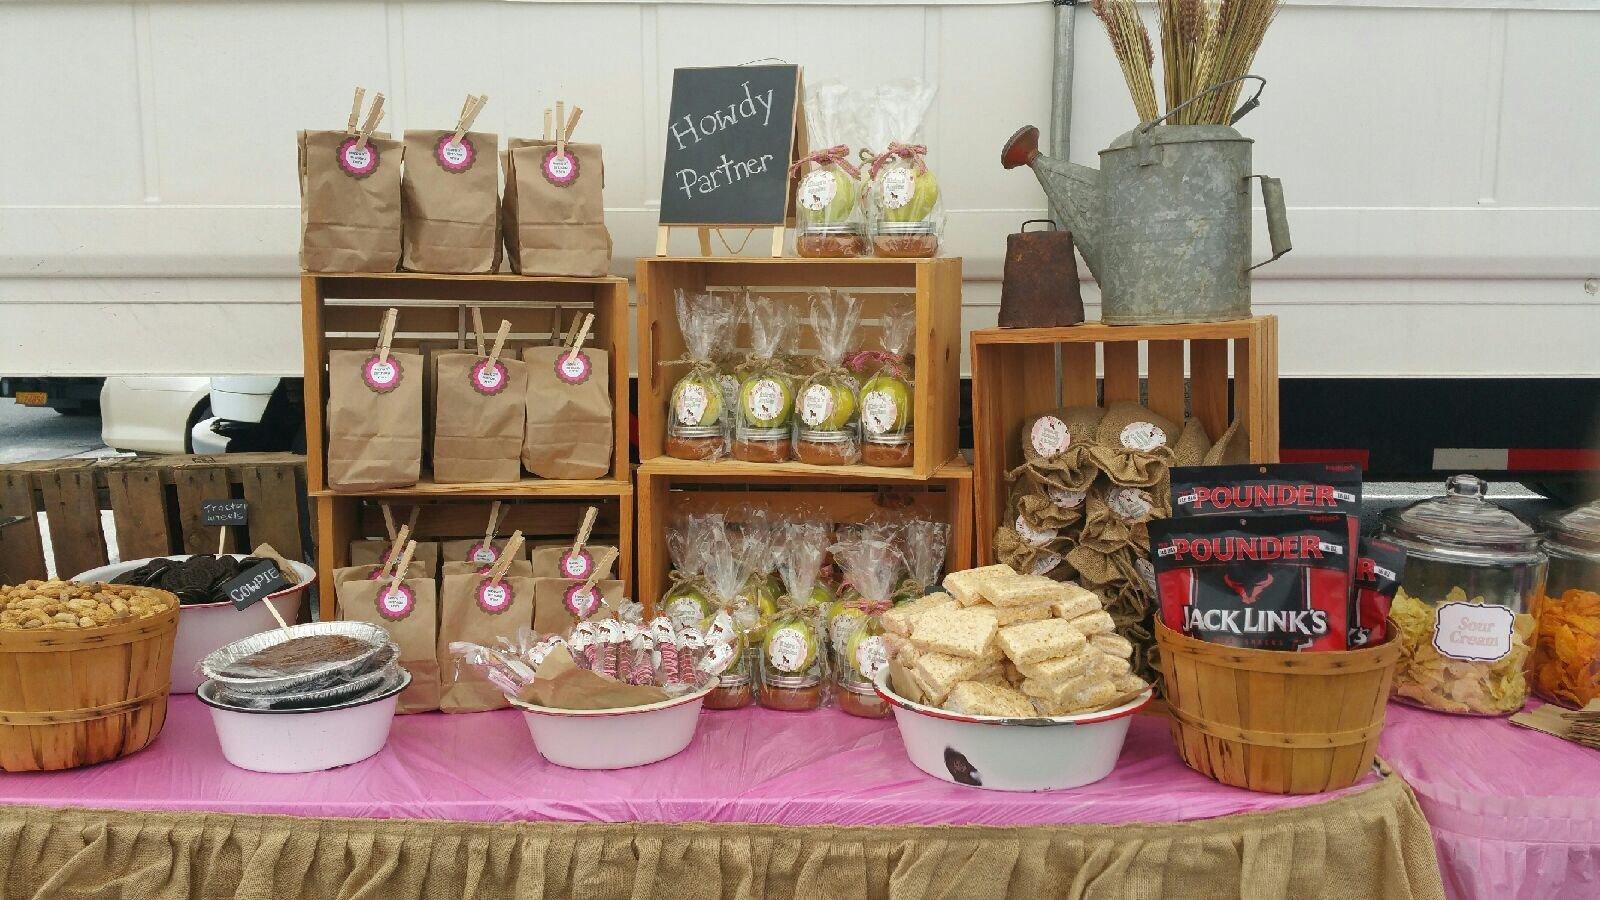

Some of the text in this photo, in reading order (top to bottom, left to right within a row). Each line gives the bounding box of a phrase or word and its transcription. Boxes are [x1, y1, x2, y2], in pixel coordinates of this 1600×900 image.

[670, 80, 774, 151] Howdy
[675, 154, 774, 200] Partner
[1193, 485, 1336, 508] POUNDER
[1173, 535, 1323, 561] POUNDER
[1183, 606, 1327, 634] JACK LINK'S
[1457, 616, 1496, 633] Sour
[1449, 631, 1499, 647] Cream
